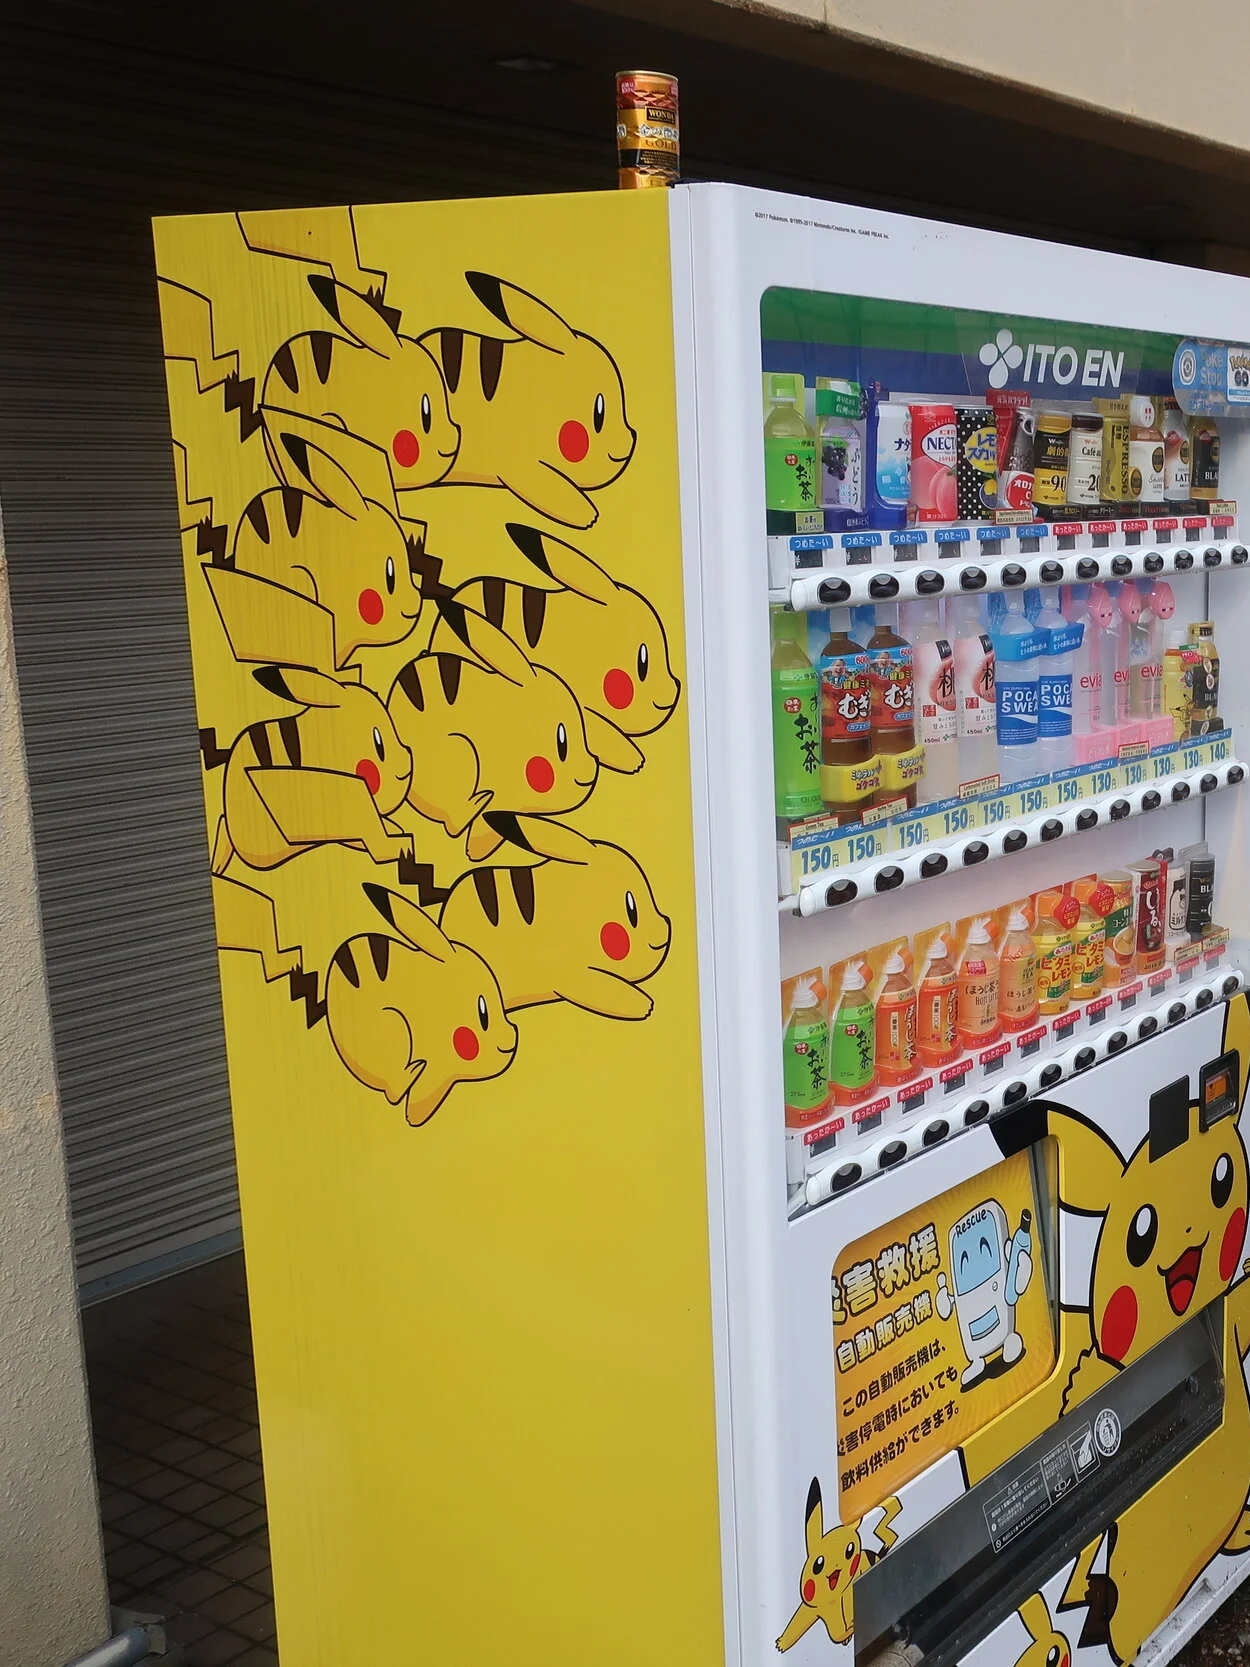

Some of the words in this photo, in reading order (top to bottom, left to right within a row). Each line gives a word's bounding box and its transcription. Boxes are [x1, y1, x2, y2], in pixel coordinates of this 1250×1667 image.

[1023, 343, 1078, 384] ITO
[1081, 350, 1125, 388] EN
[851, 448, 860, 505] ぶどう
[1121, 425, 1129, 495] ESPRESSO
[793, 713, 821, 774] お茶
[904, 1004, 917, 1061] ほうじ茶
[945, 988, 957, 1042] ほうじ茶
[807, 1048, 827, 1090] お茶
[856, 1030, 873, 1070] お茶
[854, 1100, 889, 1121] あったか〜い
[899, 1080, 931, 1100] あったか〜い
[806, 1121, 843, 1142] あったか〜い
[956, 1209, 987, 1239] Rescue
[837, 1291, 933, 1374] 自動販売機
[842, 1338, 946, 1417] この自動販売機は、
[841, 1398, 960, 1492] 飲料供給ができます。
